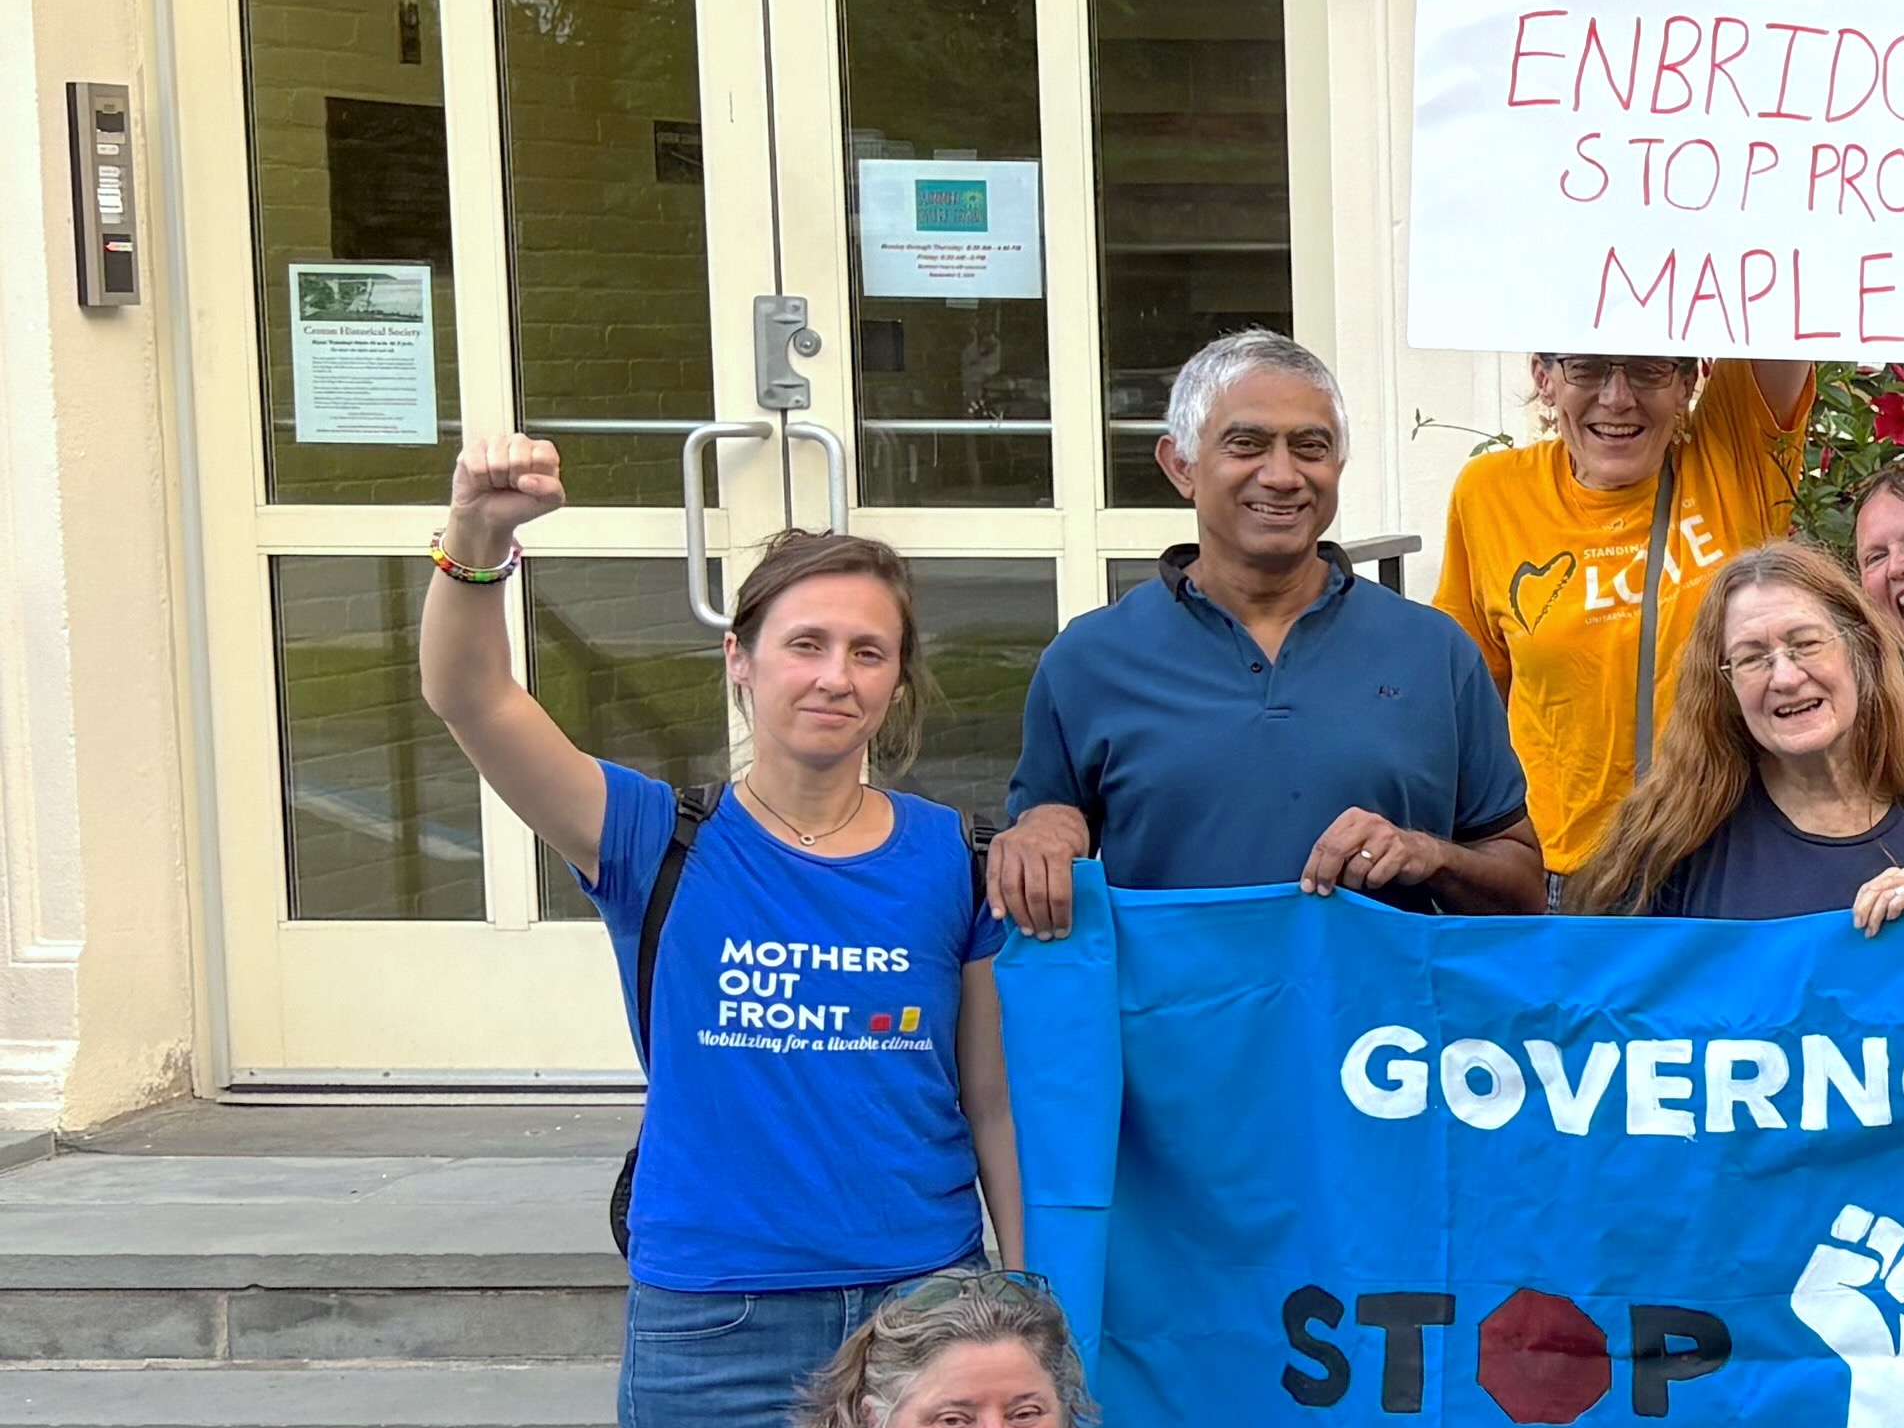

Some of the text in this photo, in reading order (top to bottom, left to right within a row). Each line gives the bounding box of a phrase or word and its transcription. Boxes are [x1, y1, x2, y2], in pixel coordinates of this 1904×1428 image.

[1560, 133, 1778, 211] STOP
[1583, 544, 1640, 560] STANDIN
[720, 937, 910, 973] MOTHERS
[718, 969, 801, 999] OUT
[718, 1000, 850, 1032] FRONT
[697, 1030, 782, 1053] Mobilizing
[781, 1034, 809, 1054] for
[811, 1037, 824, 1051] a
[827, 1036, 880, 1051] livable
[1281, 1284, 1732, 1425] STOP
